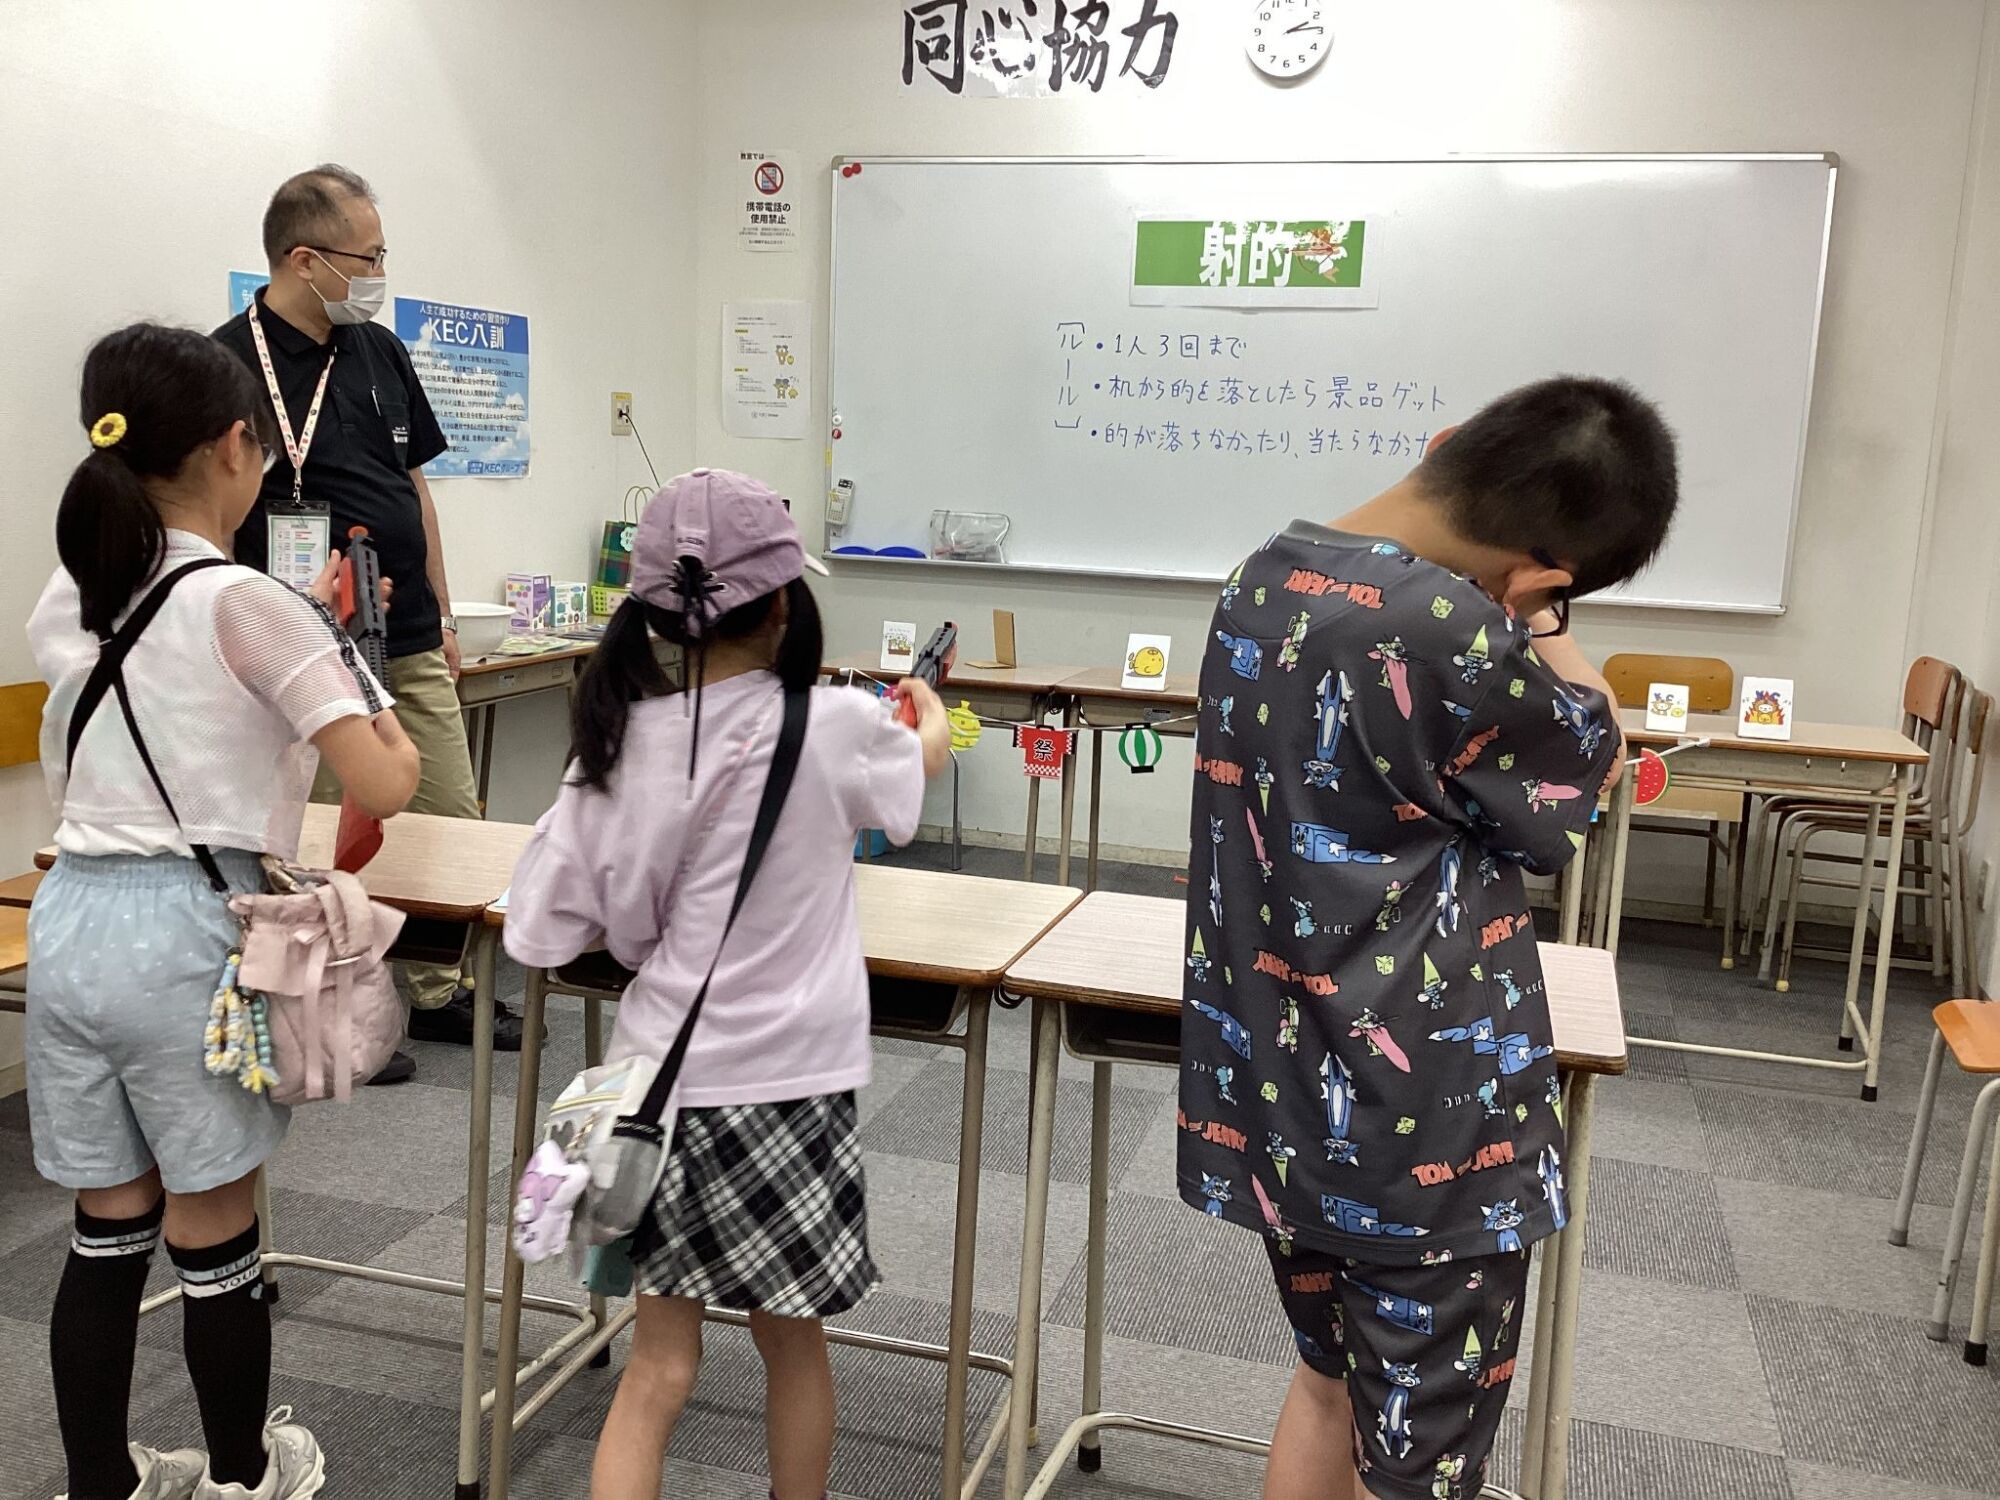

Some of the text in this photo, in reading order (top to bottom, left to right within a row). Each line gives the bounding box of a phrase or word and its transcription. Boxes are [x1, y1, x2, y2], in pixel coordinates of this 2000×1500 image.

[1260, 12, 1271, 21] 10
[1312, 11, 1320, 20] 2
[1254, 28, 1262, 36] 9
[902, 0, 1179, 94] 同心協力
[1257, 43, 1265, 52] 8
[1309, 42, 1317, 51] 4
[1270, 55, 1277, 64] 7
[1298, 54, 1306, 63] 5
[1282, 60, 1290, 68] 6
[746, 201, 791, 213] 携帯電話の
[751, 214, 787, 225] 使用禁止
[1199, 220, 1297, 287] 射的
[428, 317, 505, 350] KEC八訓
[1346, 583, 1385, 609] TOM
[1033, 737, 1057, 761] 祭
[1411, 1161, 1455, 1187] TOM
